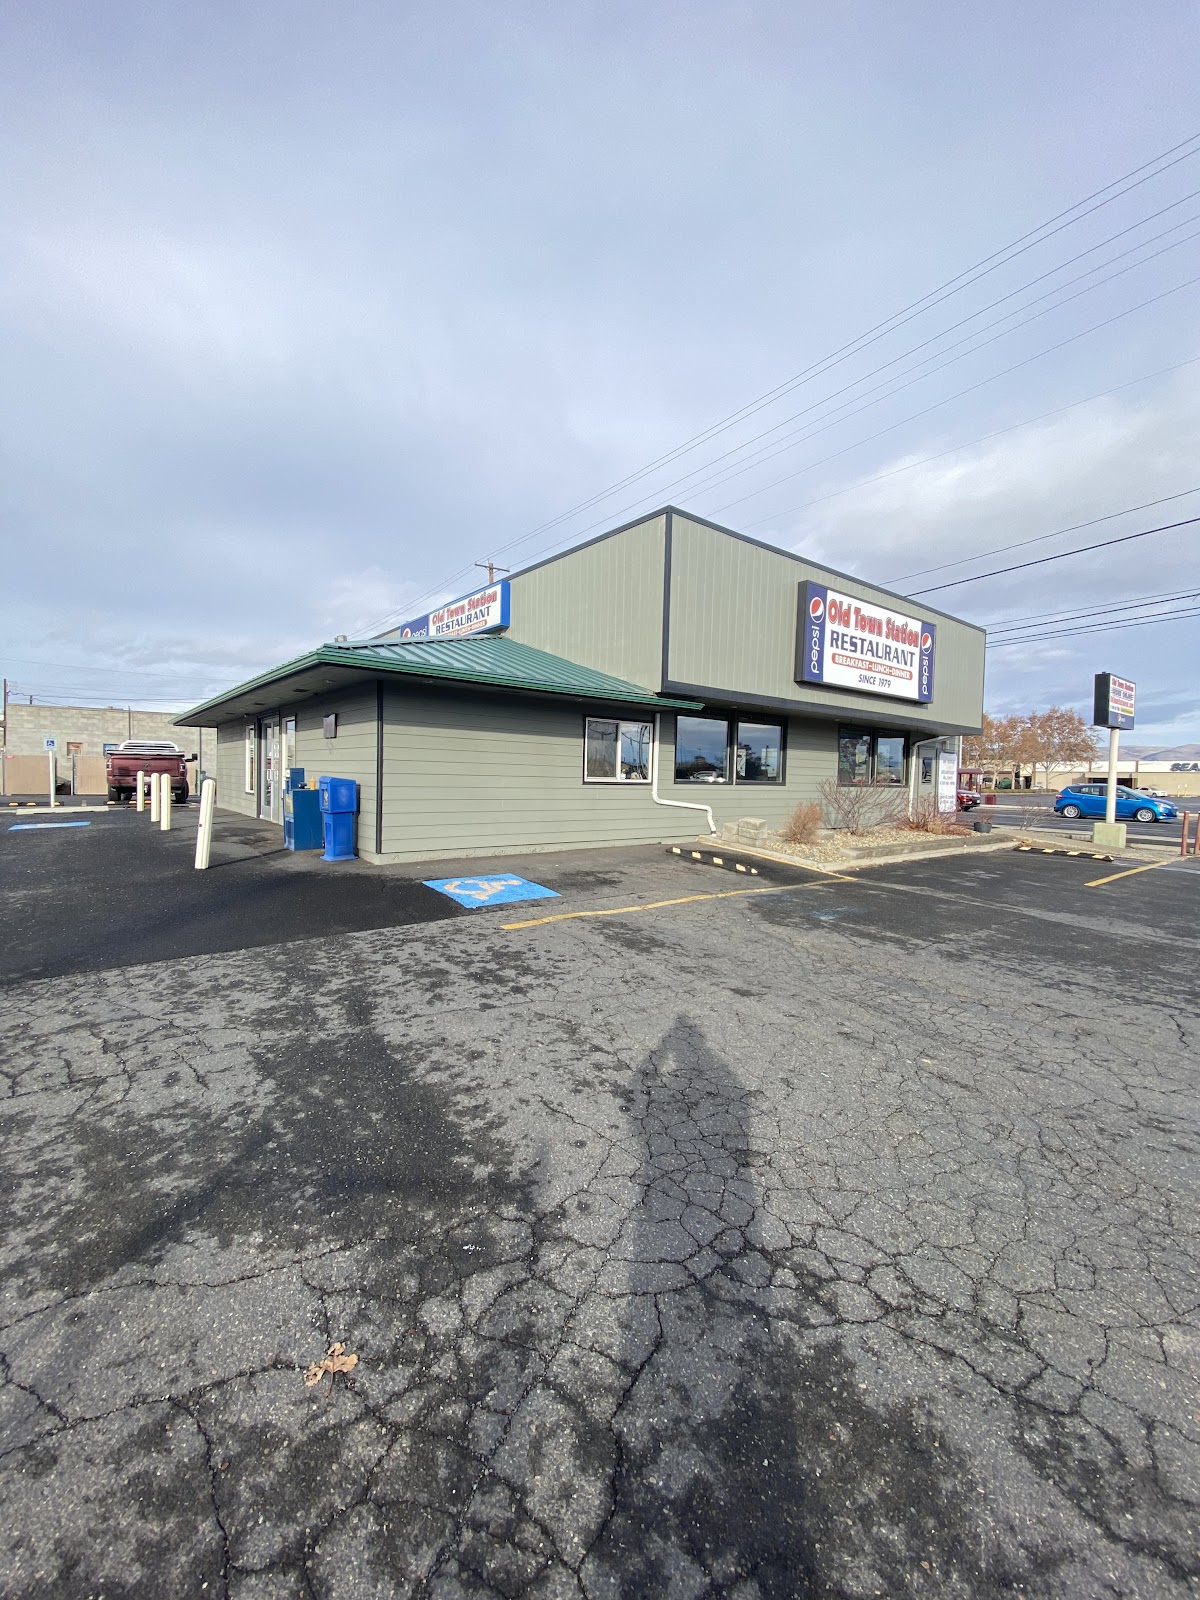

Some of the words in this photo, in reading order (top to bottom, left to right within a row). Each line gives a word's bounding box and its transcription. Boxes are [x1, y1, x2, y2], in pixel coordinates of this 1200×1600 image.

[432, 610, 445, 626] Old
[446, 604, 466, 620] Town
[467, 590, 497, 612] Station
[436, 606, 491, 635] RESTAURANT
[828, 599, 852, 628] Old
[854, 607, 883, 637] Town
[885, 617, 919, 648] Station
[811, 625, 821, 674] pepsi
[830, 629, 916, 668] RESTAURANT
[858, 673, 877, 686] SINCE
[878, 677, 892, 689] 1979
[1169, 762, 1200, 772] SEA
